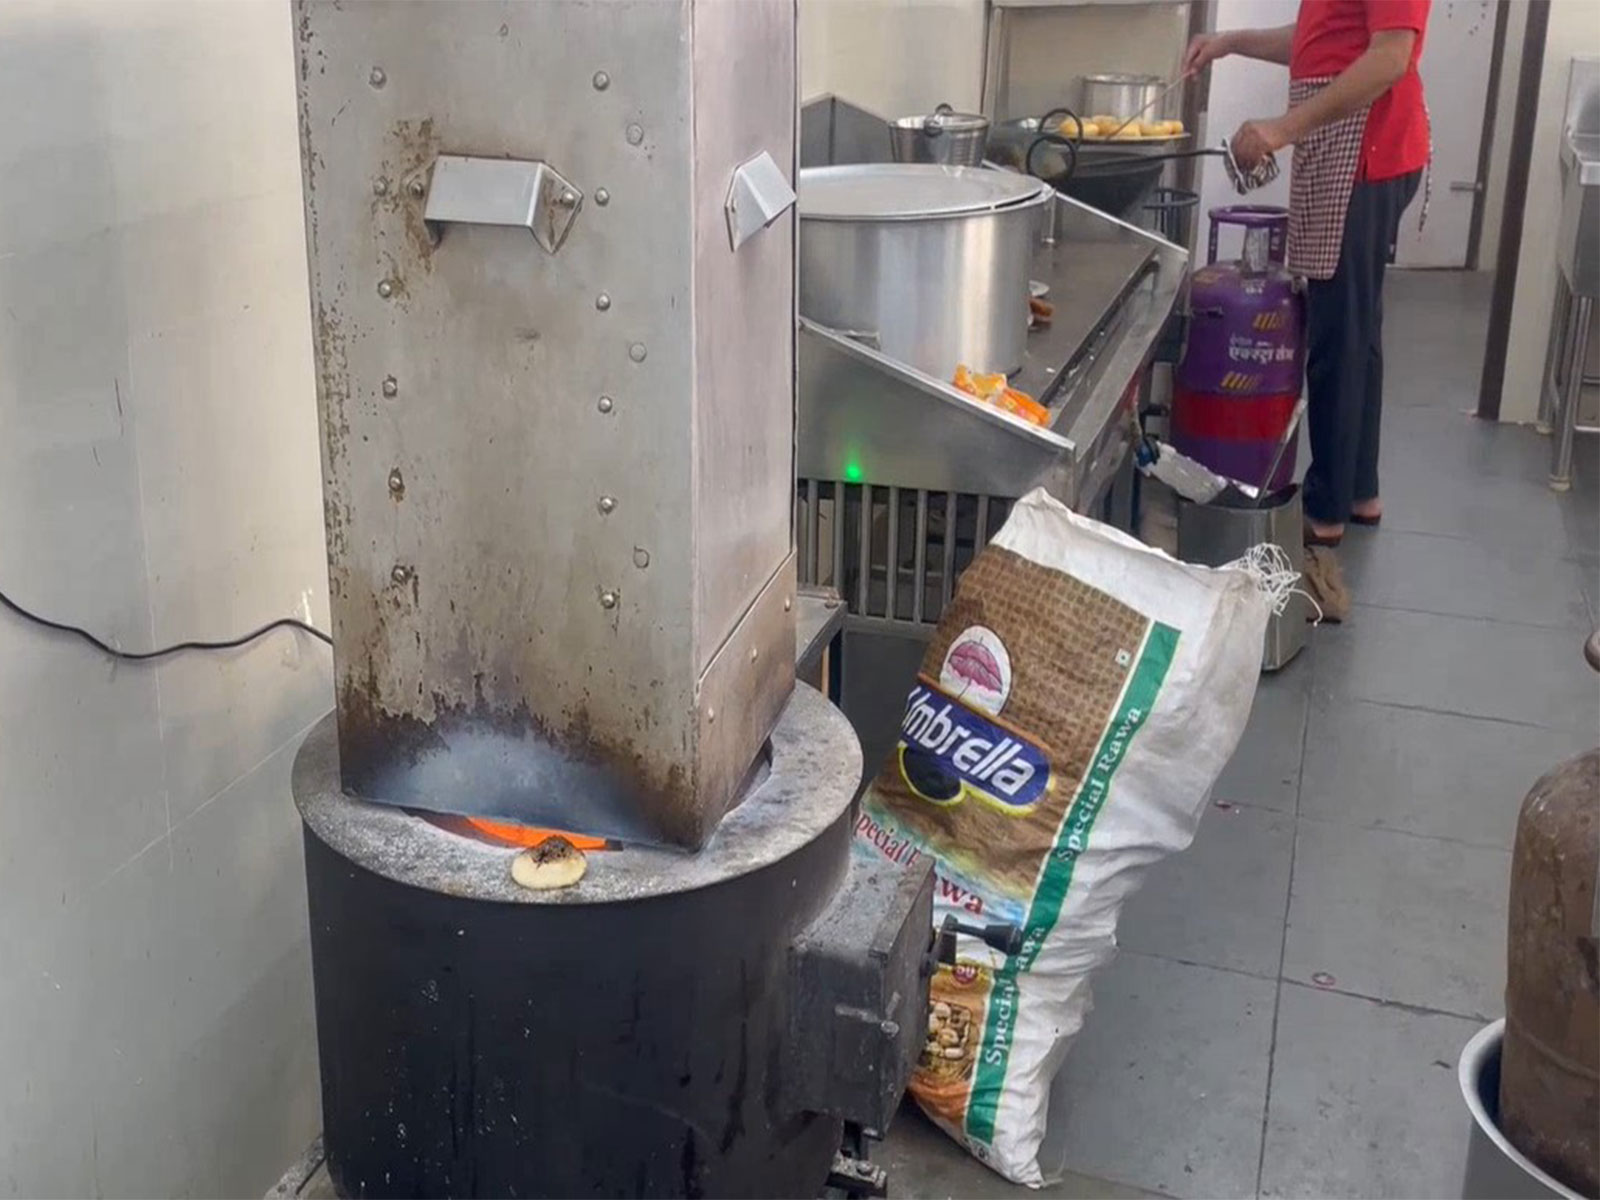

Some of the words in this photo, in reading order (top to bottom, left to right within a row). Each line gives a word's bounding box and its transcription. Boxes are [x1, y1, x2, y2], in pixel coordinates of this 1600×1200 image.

[1057, 777, 1105, 863] Special
[1097, 706, 1142, 773] Rawa
[853, 810, 909, 863] pecial
[1014, 927, 1045, 970] awa
